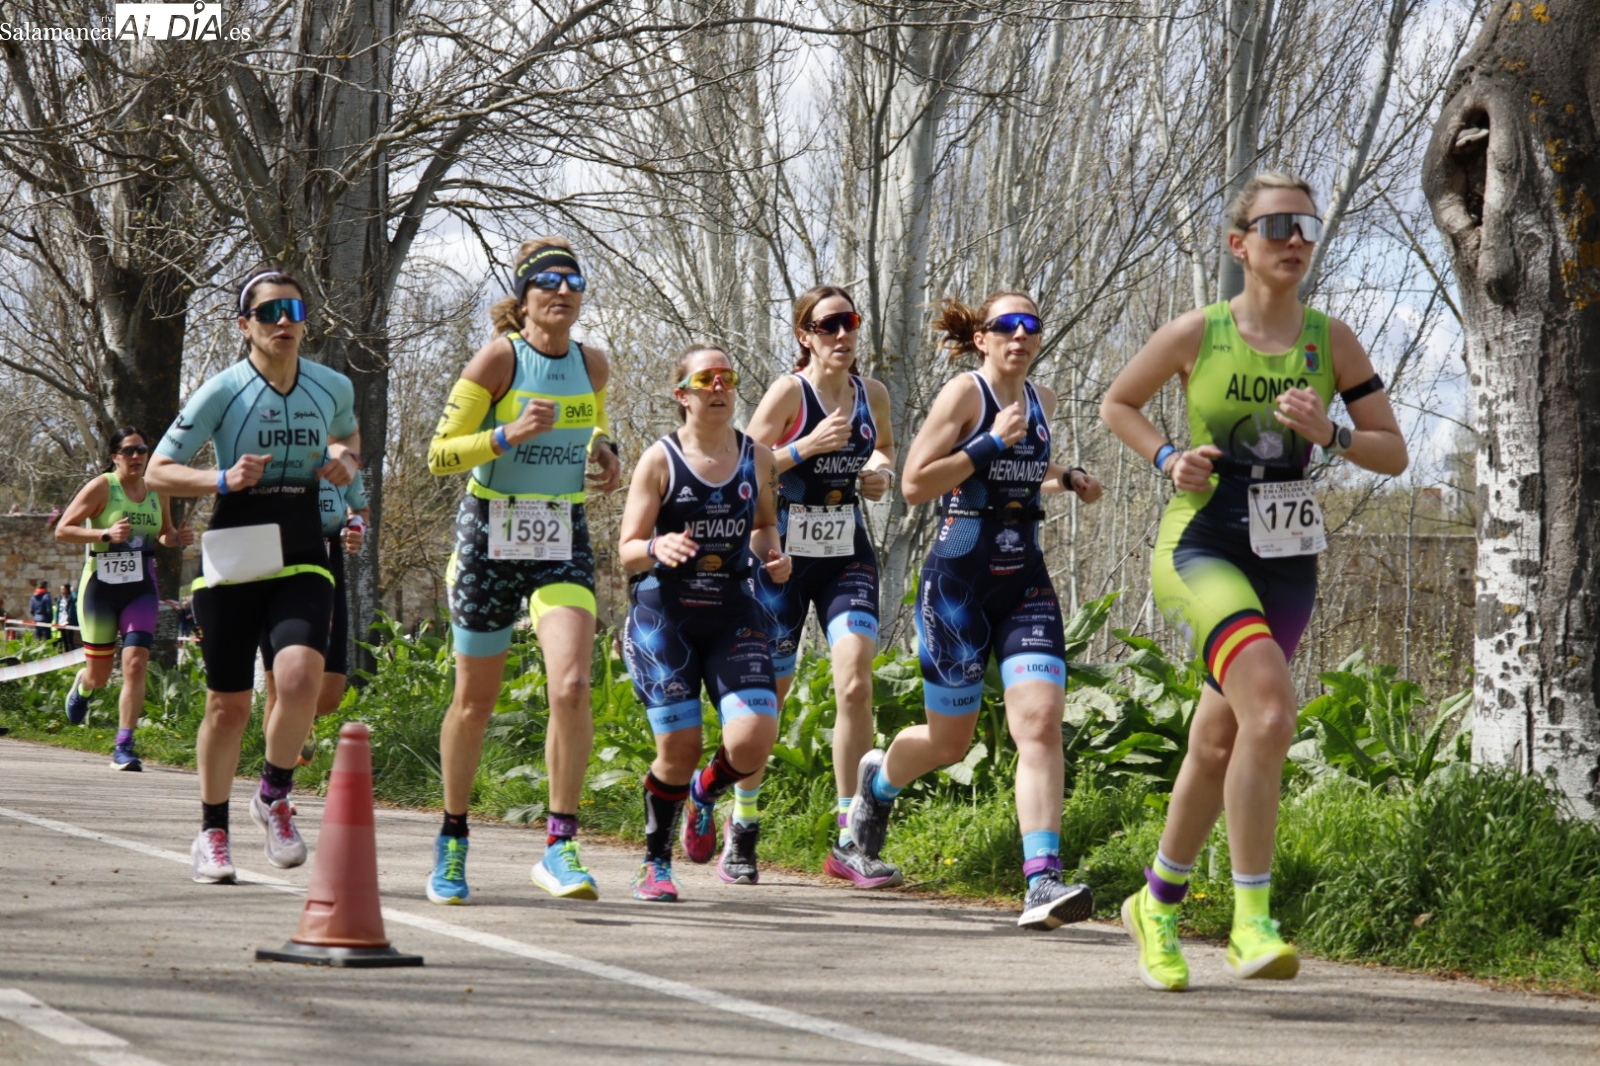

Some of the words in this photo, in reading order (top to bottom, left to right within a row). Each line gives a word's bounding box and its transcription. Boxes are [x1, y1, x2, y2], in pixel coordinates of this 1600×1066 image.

[258, 428, 320, 448] URIEN
[814, 456, 868, 474] SANCHEZ
[988, 460, 1048, 481] HERNANDEZ
[1265, 499, 1320, 530] 176
[502, 519, 560, 542] 1592
[684, 519, 746, 538] NEVADO
[798, 520, 846, 541] 1627
[104, 560, 136, 573] 1759
